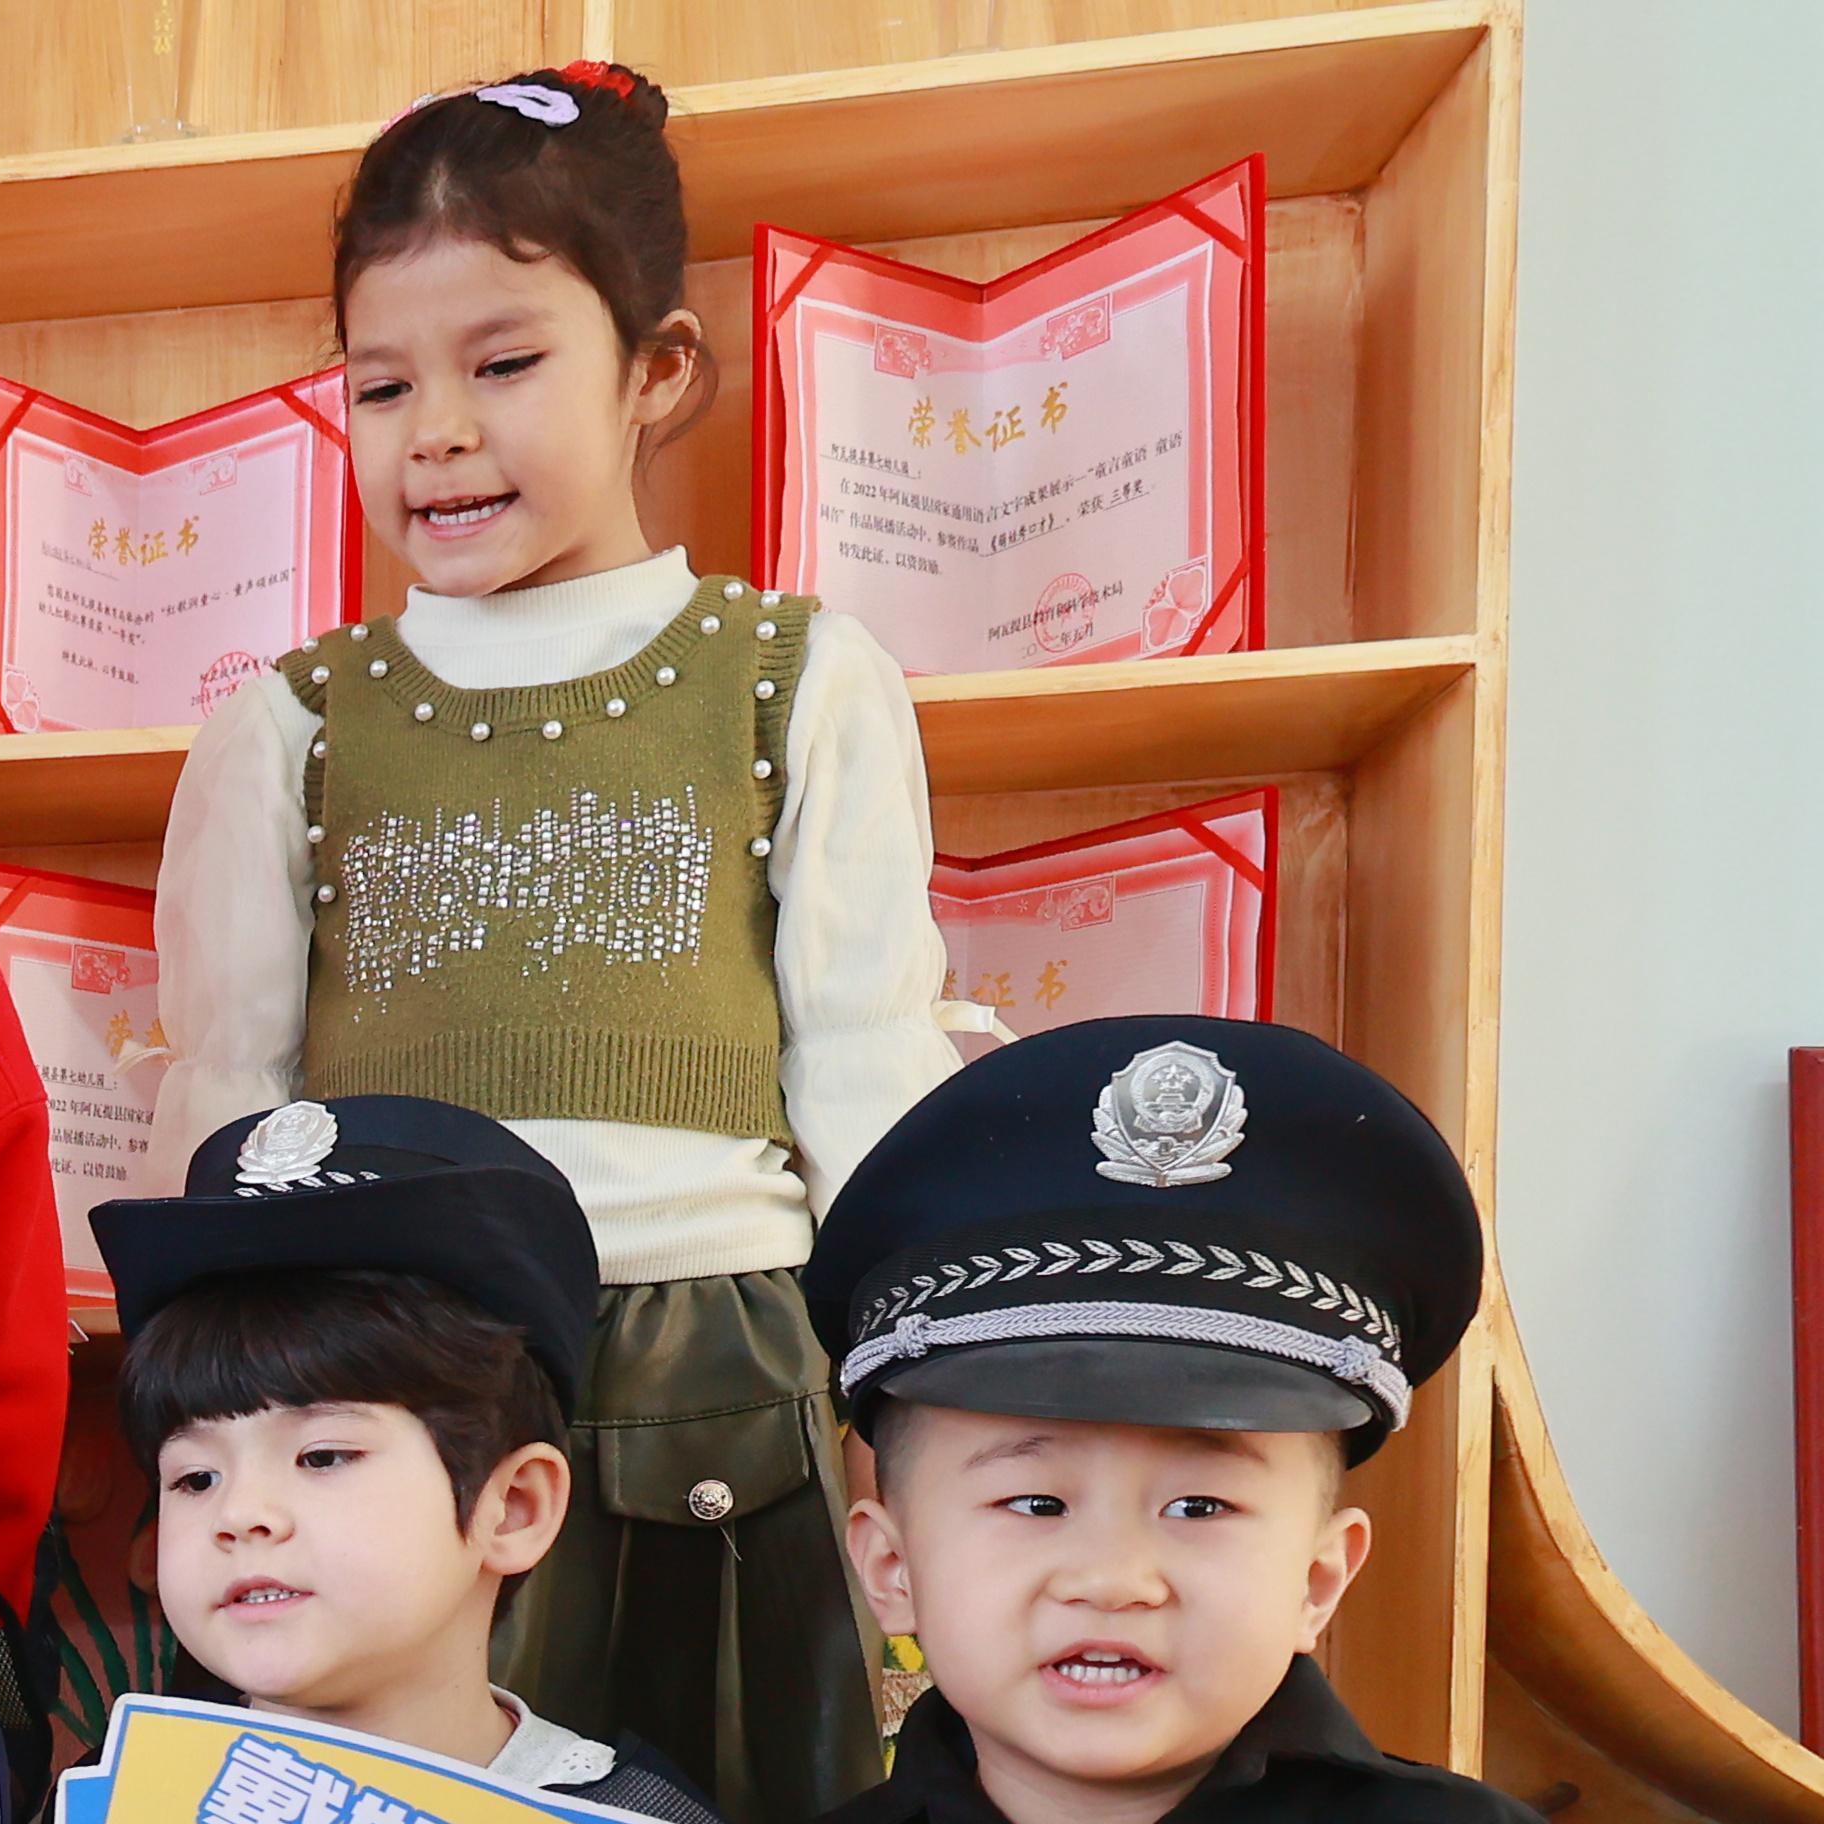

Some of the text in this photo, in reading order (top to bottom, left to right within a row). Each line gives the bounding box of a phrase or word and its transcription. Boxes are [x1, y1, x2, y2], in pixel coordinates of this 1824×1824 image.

[908, 381, 1069, 455] 荣誉证书
[88, 515, 201, 567] 荣誉证书
